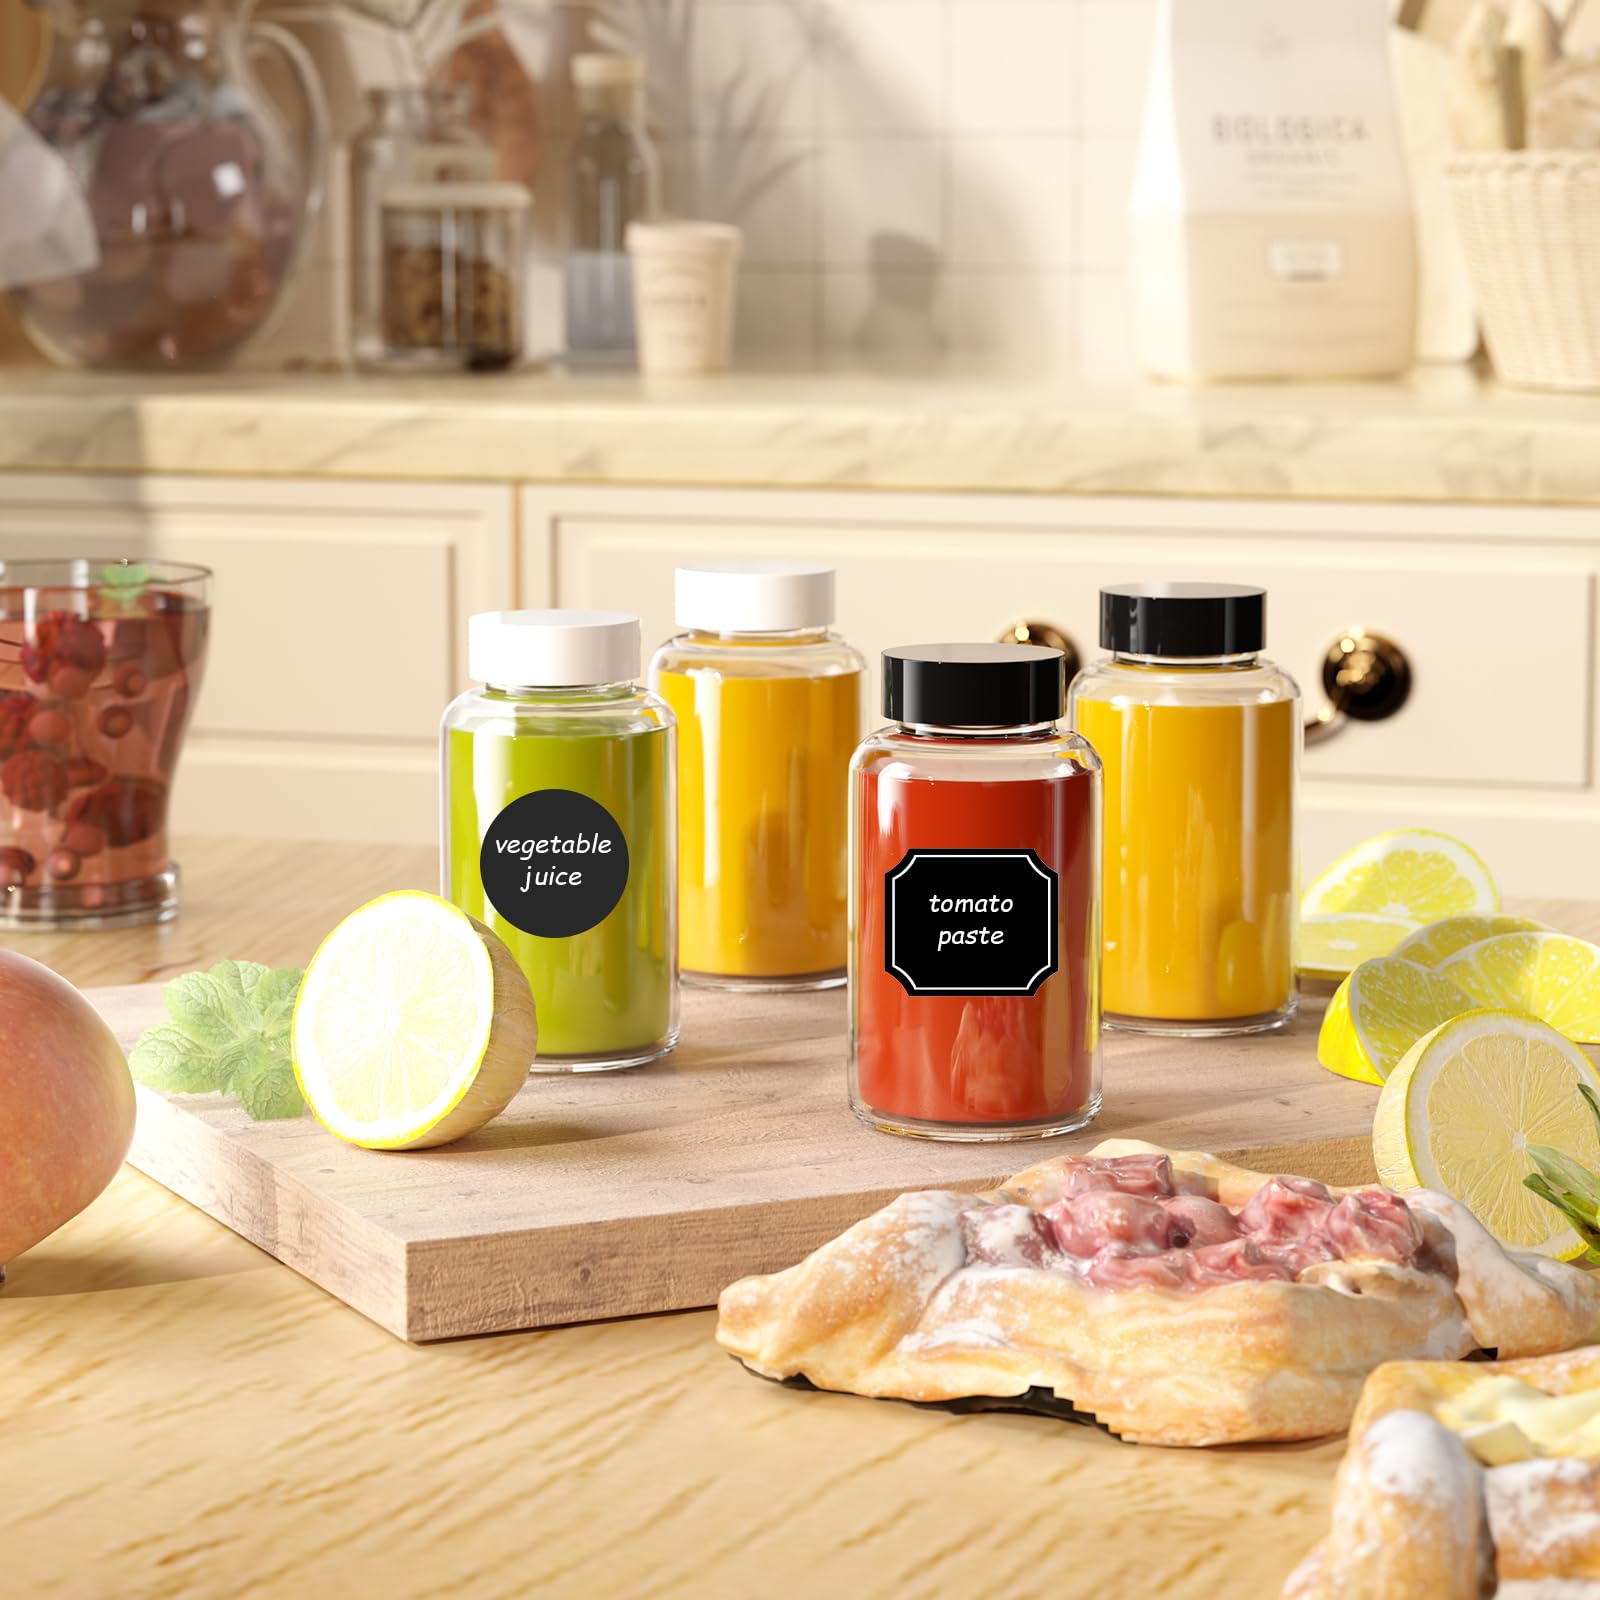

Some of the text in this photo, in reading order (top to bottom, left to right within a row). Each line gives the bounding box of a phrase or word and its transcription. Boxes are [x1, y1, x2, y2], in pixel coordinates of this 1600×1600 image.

[495, 832, 612, 861] vegetable
[519, 865, 583, 893] juice
[928, 894, 1014, 913] tomato
[937, 926, 1004, 952] paste
